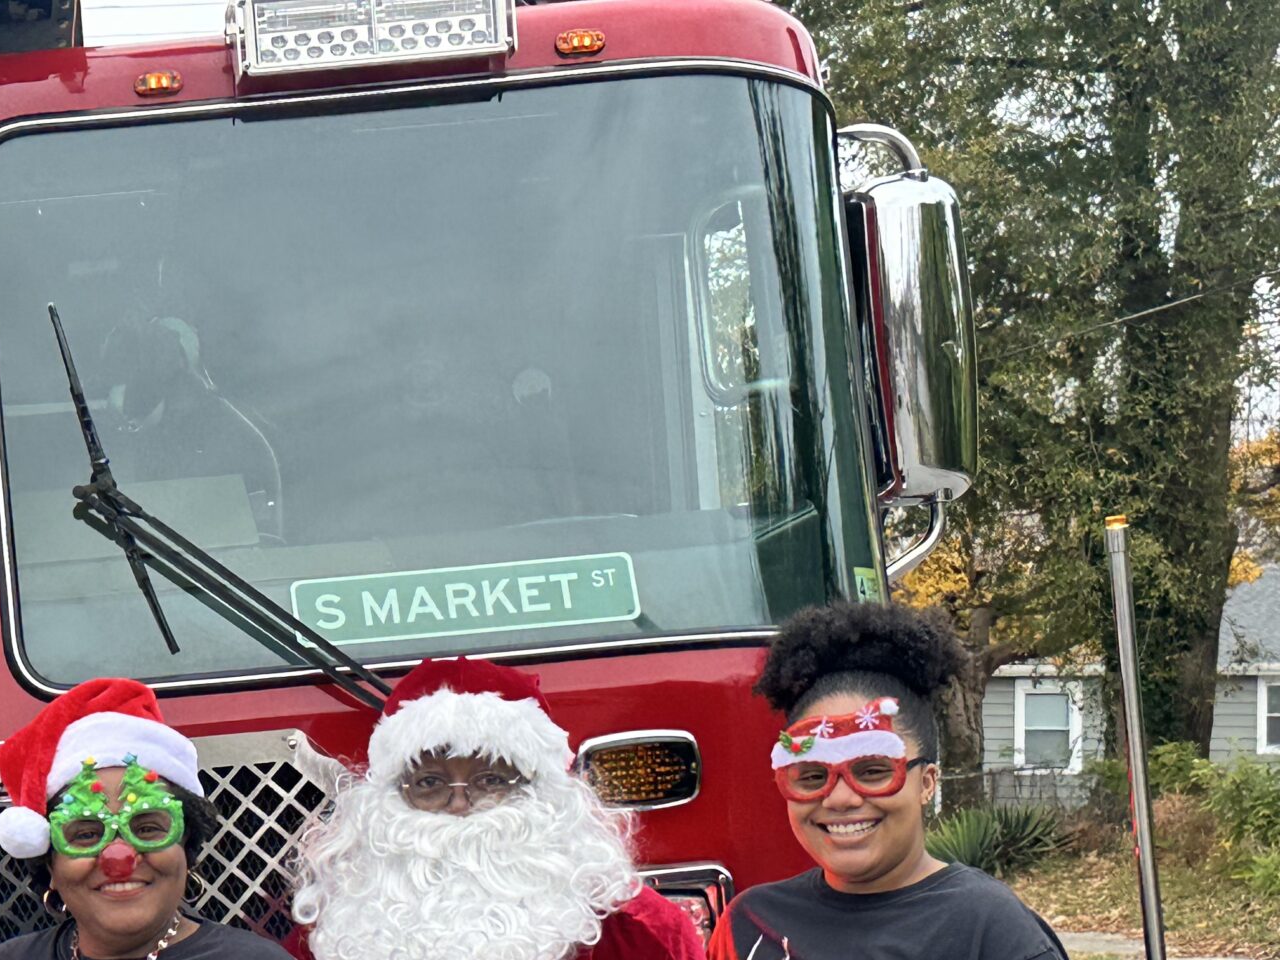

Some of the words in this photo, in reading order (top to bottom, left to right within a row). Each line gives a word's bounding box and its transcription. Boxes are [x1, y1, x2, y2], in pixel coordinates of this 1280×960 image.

[315, 593, 347, 630] S
[360, 572, 579, 627] MARKET
[591, 568, 616, 588] ST
